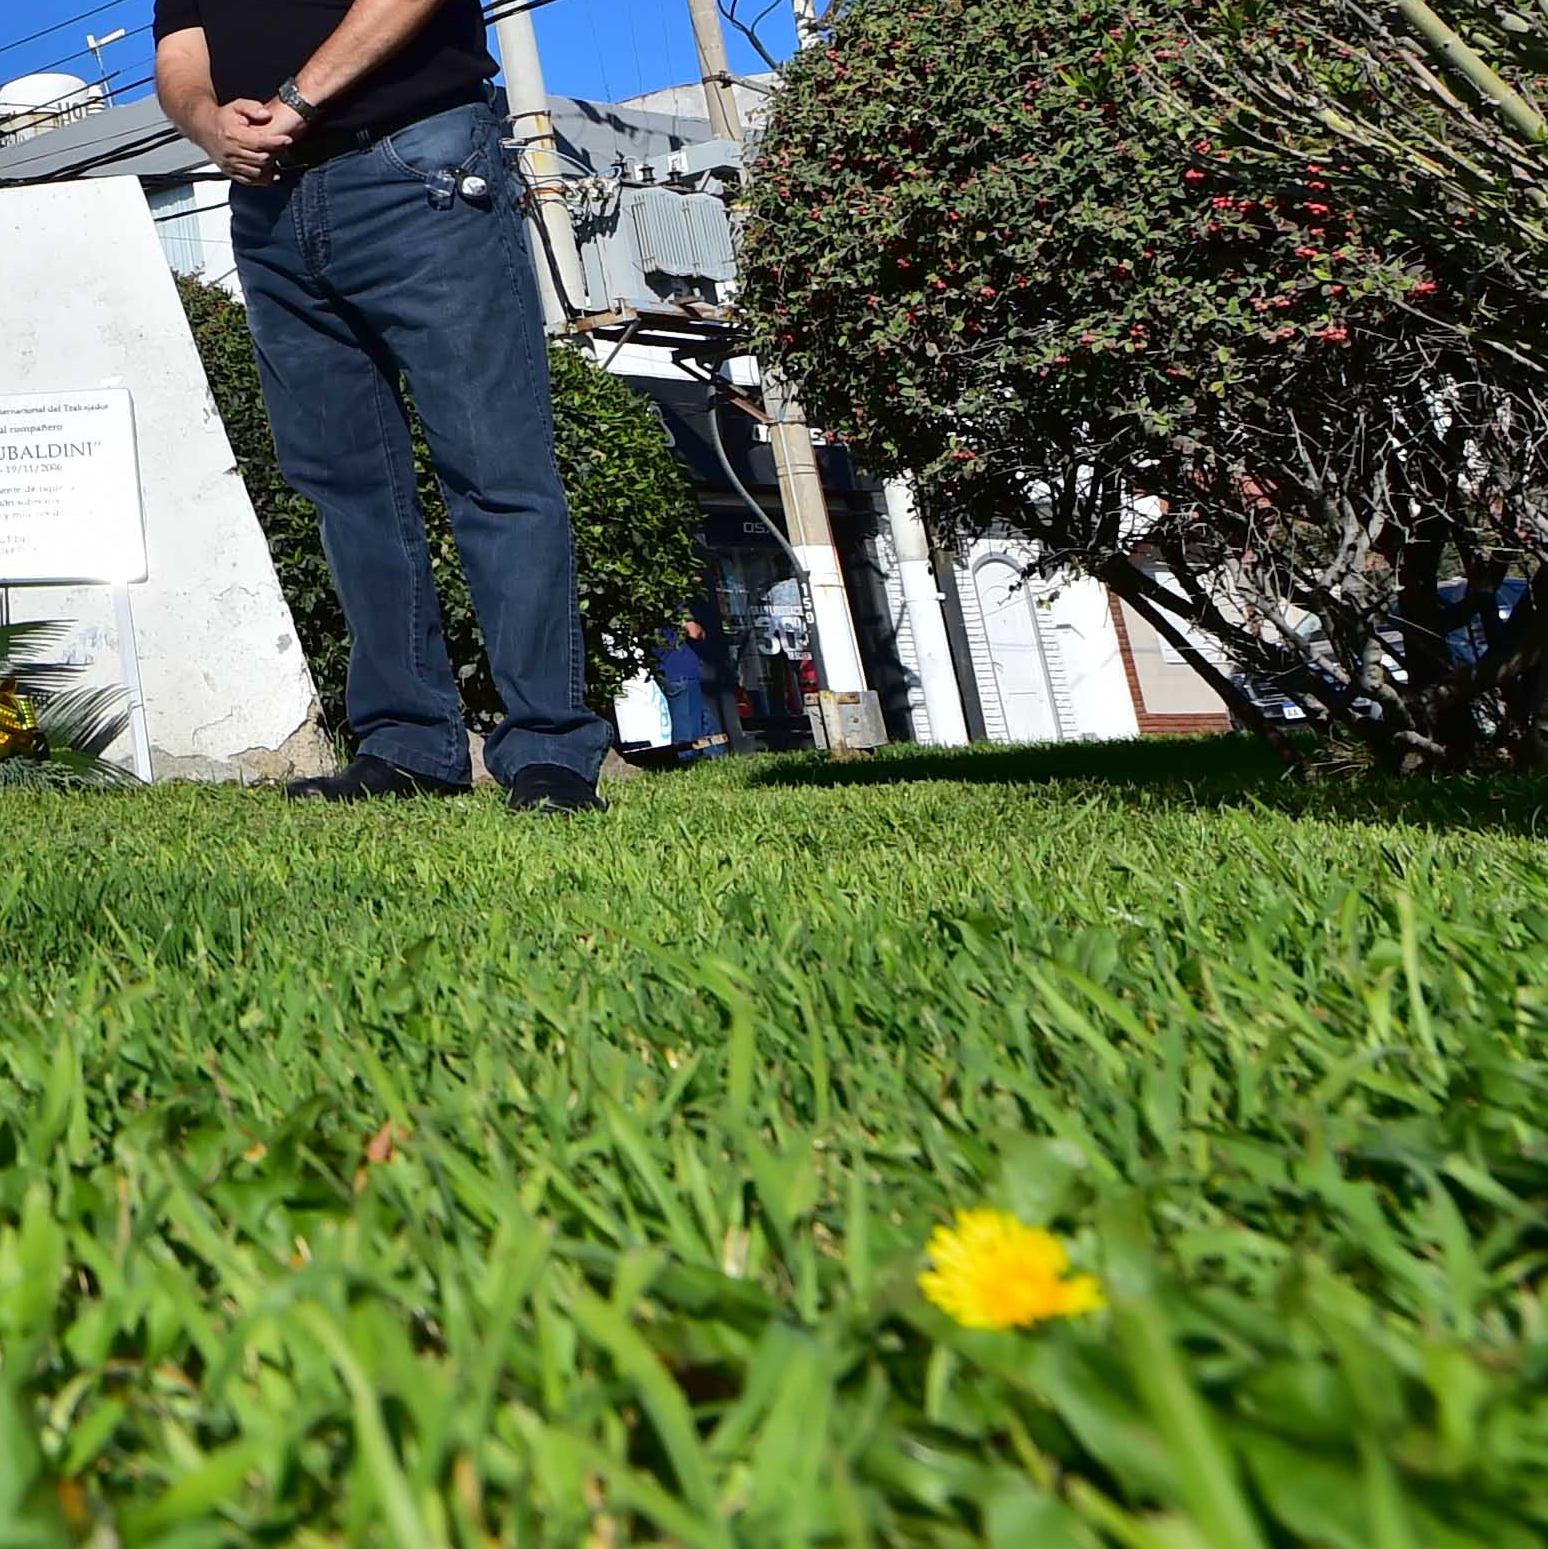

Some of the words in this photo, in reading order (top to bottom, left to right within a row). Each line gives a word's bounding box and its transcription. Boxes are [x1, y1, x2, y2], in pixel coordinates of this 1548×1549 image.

[47, 403, 61, 412] del
[63, 403, 108, 412] Trabajador
[0, 425, 7, 434] al
[10, 423, 63, 436] compañero
